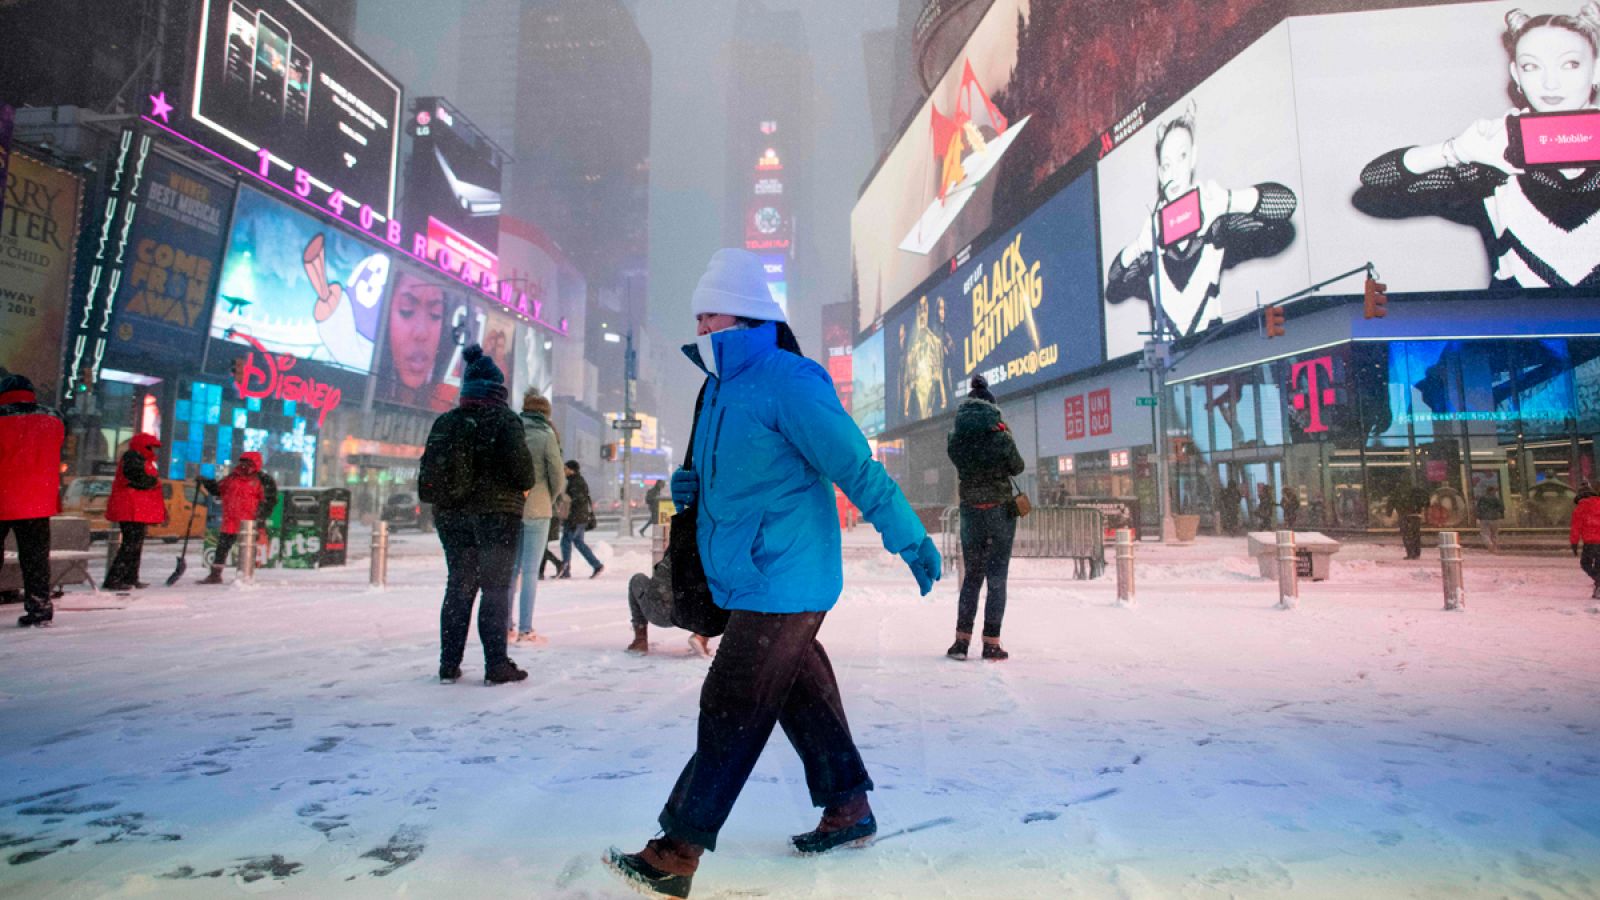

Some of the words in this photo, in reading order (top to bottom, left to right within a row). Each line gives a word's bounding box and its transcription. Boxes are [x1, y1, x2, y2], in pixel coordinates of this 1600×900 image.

[416, 126, 430, 136] LG
[137, 239, 212, 284] COME
[387, 219, 542, 321] BROADWAY
[972, 232, 1028, 327] BLACK
[125, 291, 203, 328] AWAY
[964, 260, 1042, 375] LIGHTNING
[229, 332, 341, 428] Disney
[1090, 395, 1107, 412] UNI
[1292, 356, 1336, 433] T
